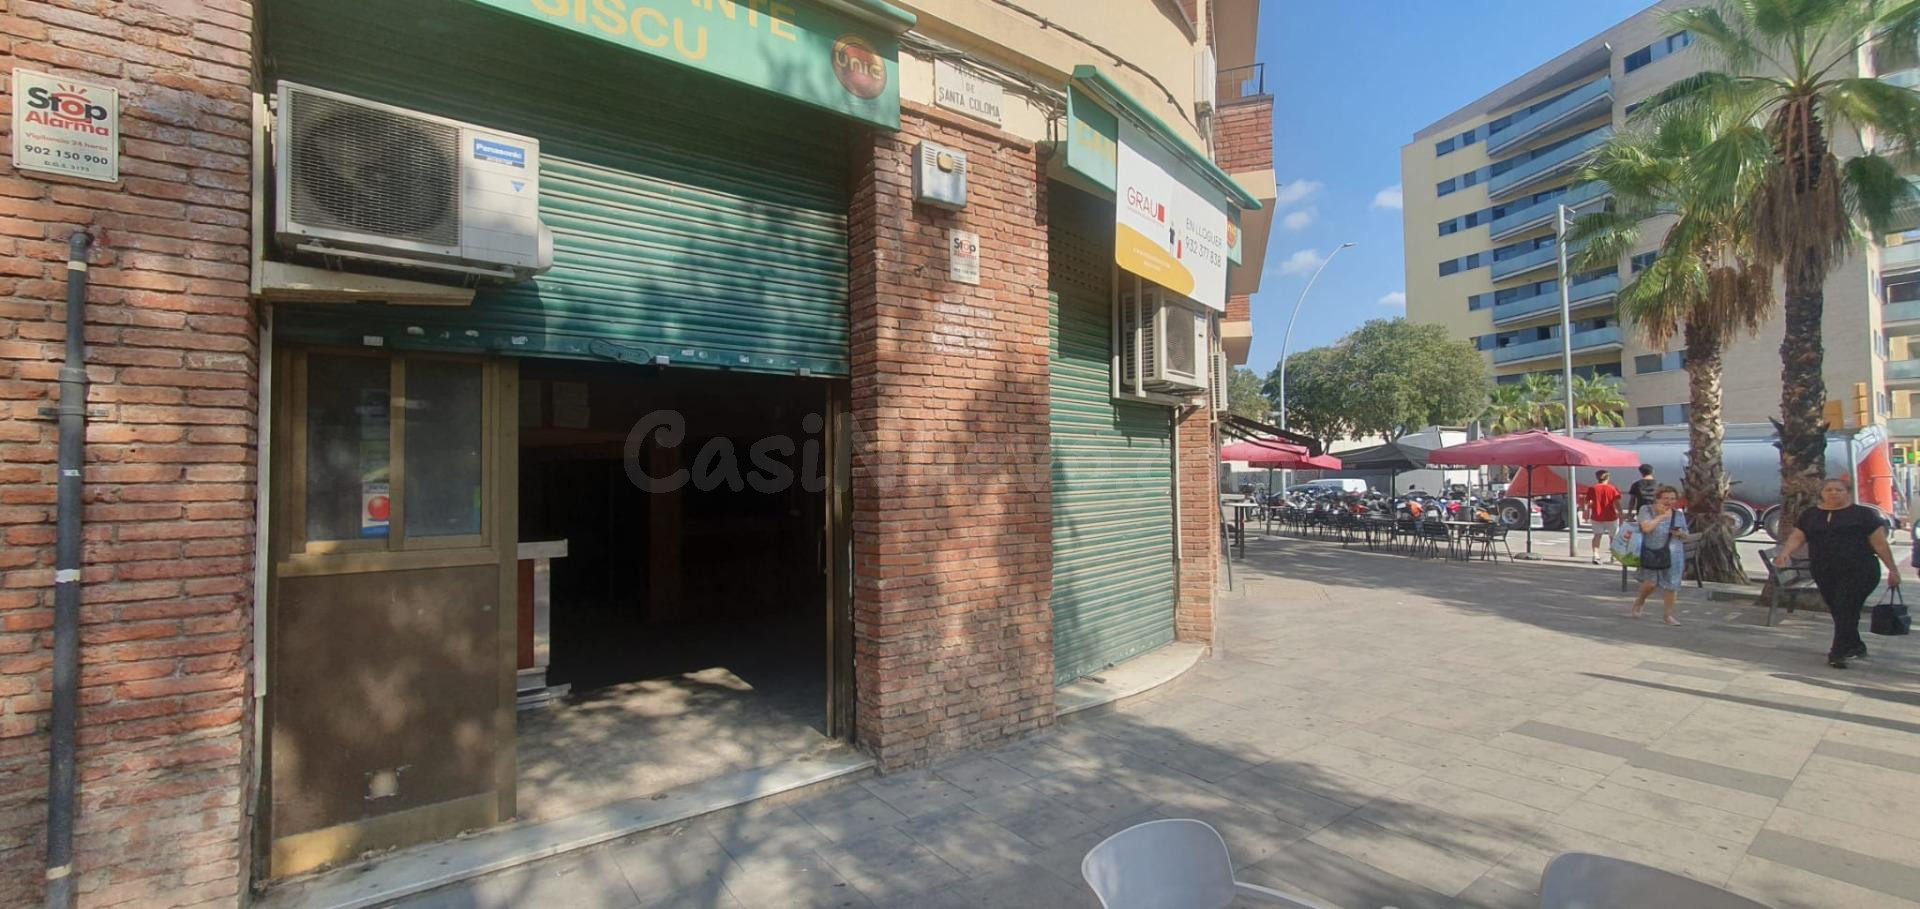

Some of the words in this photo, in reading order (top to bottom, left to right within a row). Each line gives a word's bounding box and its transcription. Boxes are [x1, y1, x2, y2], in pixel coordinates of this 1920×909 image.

[27, 86, 108, 124] Stop
[938, 86, 965, 106] SANTA
[968, 97, 1000, 117] COLOMA
[26, 111, 109, 136] Alarma
[25, 144, 51, 155] 902
[56, 150, 80, 160] 150
[84, 154, 108, 165] 900
[1127, 186, 1158, 218] GRAU
